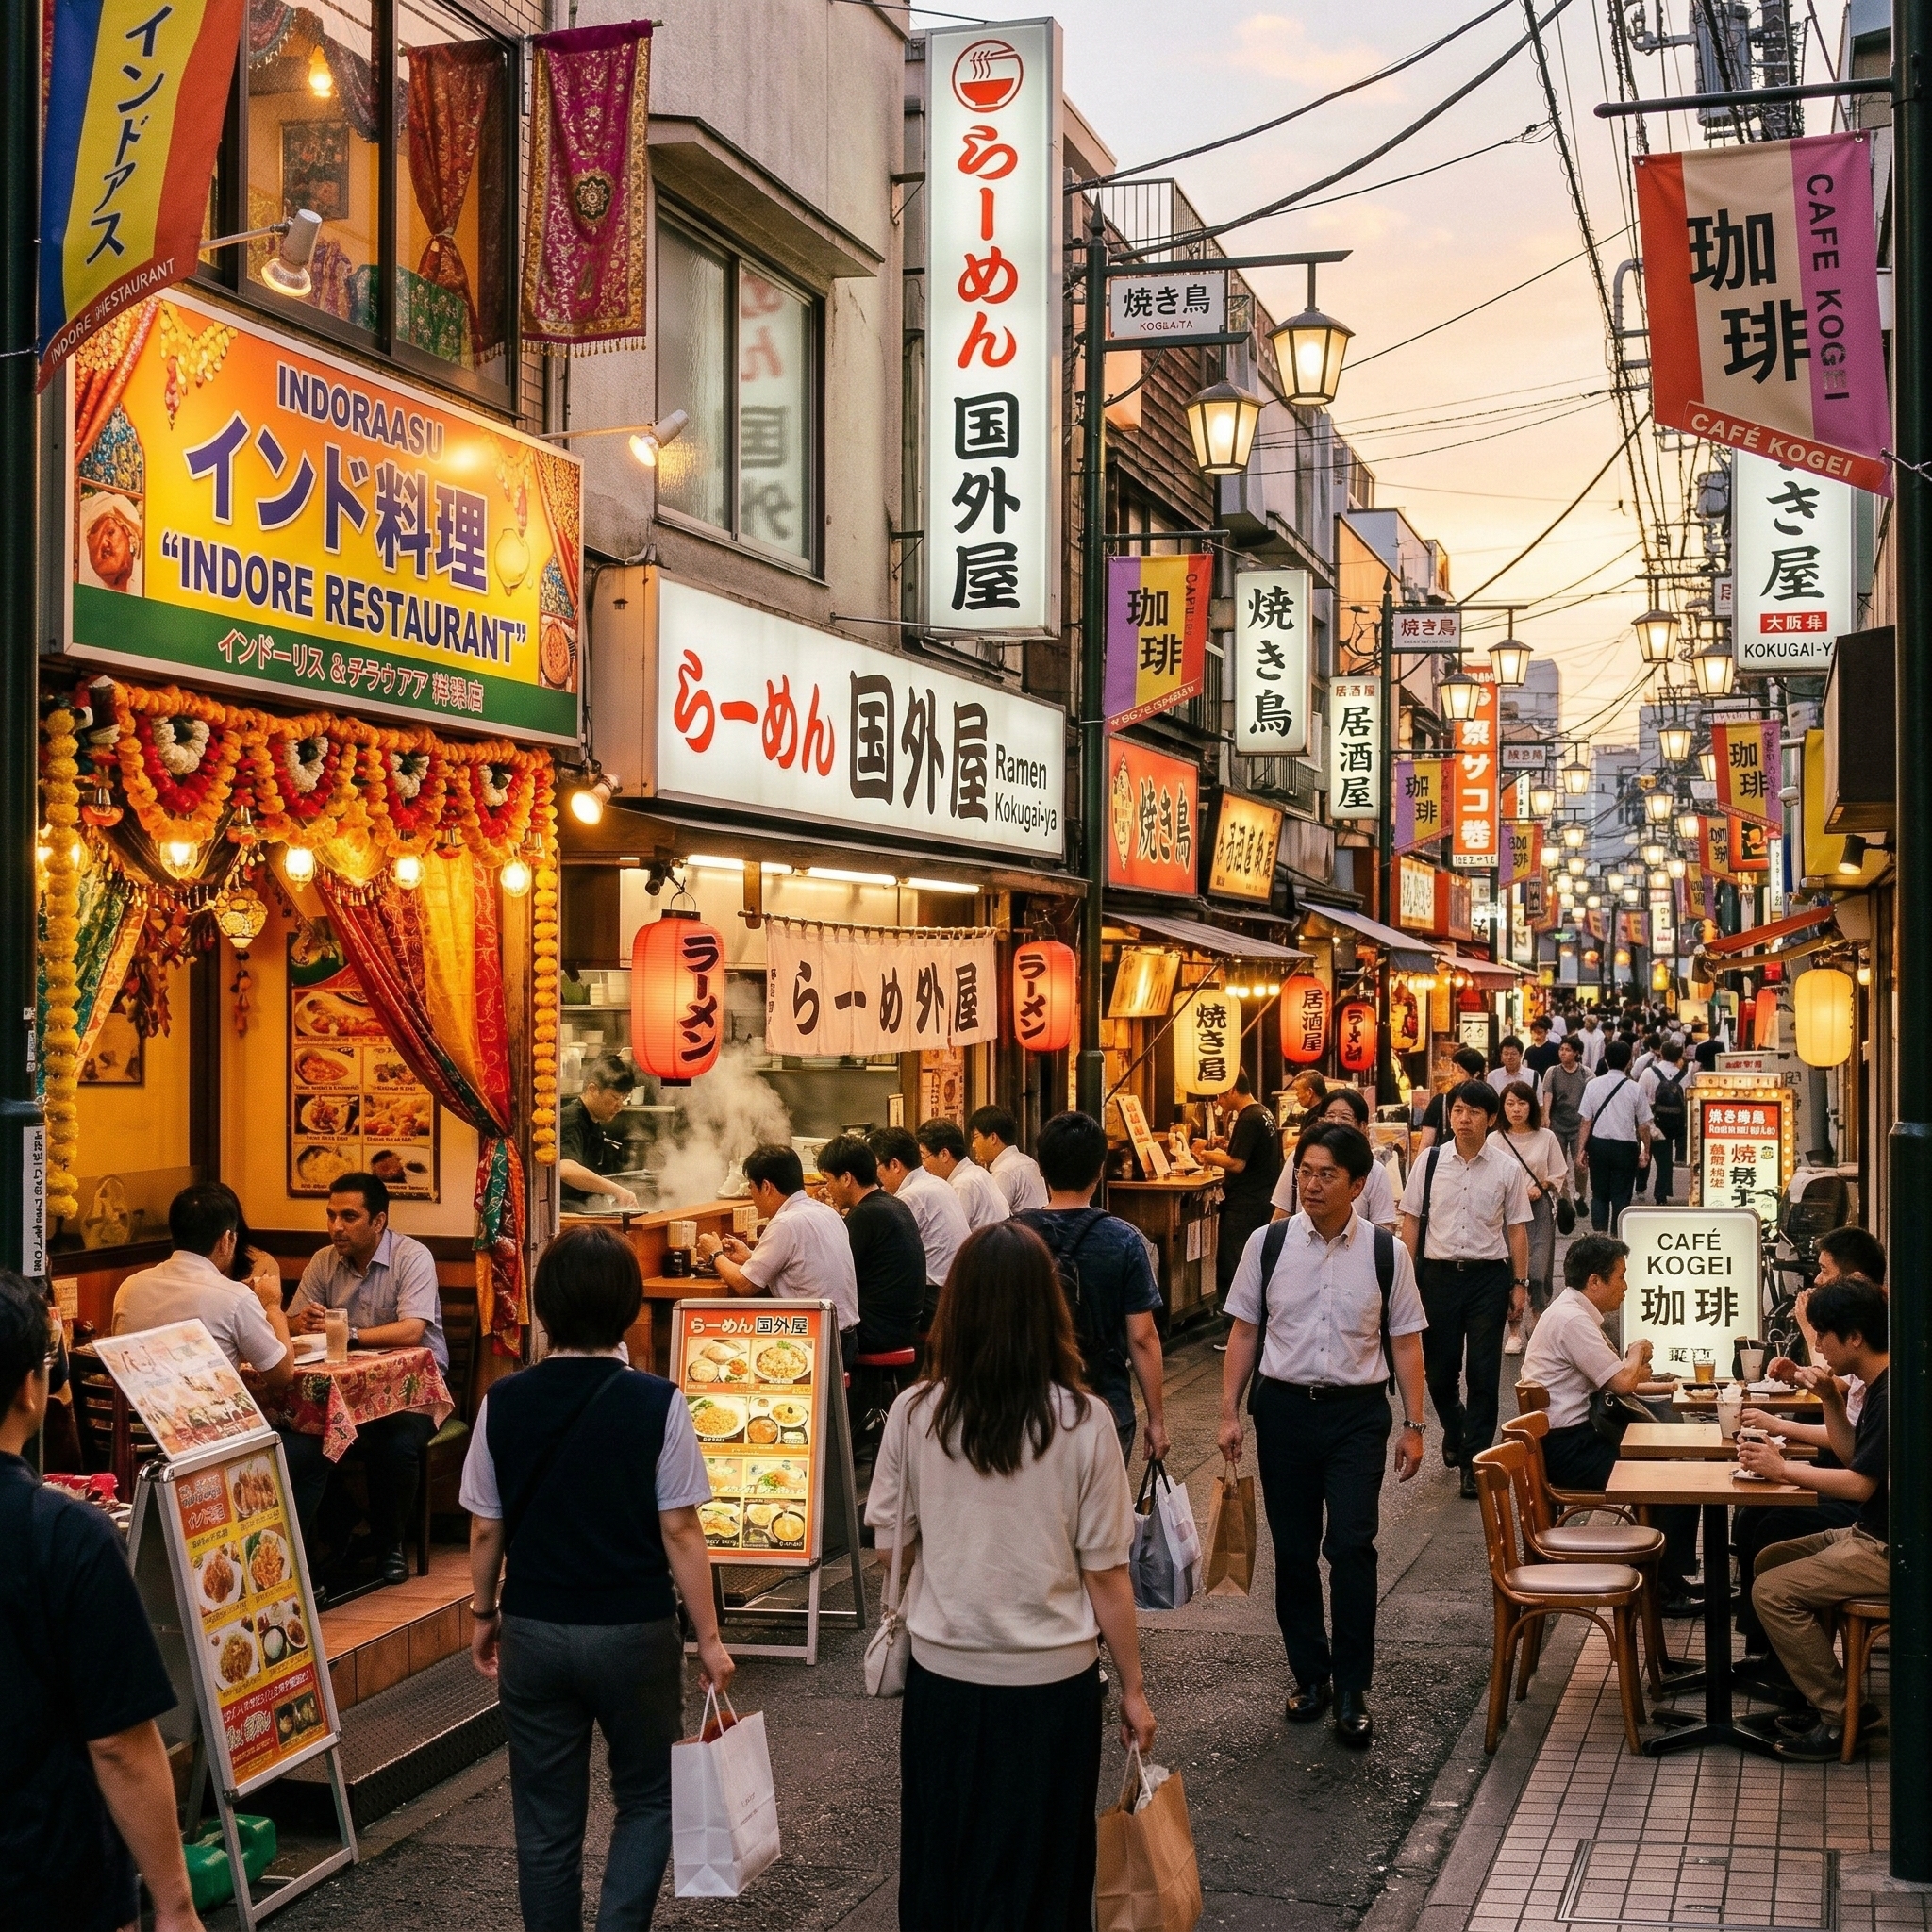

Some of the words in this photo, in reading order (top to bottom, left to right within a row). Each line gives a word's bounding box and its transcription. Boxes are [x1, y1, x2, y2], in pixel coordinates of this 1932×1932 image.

[86, 6, 174, 266] インドアス
[1807, 173, 1840, 273] CAFE
[1124, 283, 1211, 318] 焼き鳥
[1687, 208, 1812, 384] 珈琲
[278, 364, 445, 463] INDORAASU
[1690, 412, 1762, 450] CAFÉ
[1767, 430, 1854, 479] KOGEI
[184, 412, 490, 592] インド料理
[1759, 463, 1826, 602] き屋
[1126, 586, 1183, 676] 珈琲
[1247, 585, 1296, 738] 焼き鳥
[1744, 641, 1836, 659] KOKUGAI-Y
[673, 648, 836, 777] らーめん
[849, 669, 989, 824] 国外屋
[995, 743, 1047, 791] Ramen
[1337, 706, 1374, 808] 居酒屋
[678, 933, 721, 1063] ラーメン
[1018, 952, 1047, 1041] ラーメン
[1646, 1256, 1733, 1276] KOGEI
[1657, 1227, 1722, 1252] CAFÉ
[1641, 1285, 1740, 1328] 珈琲
